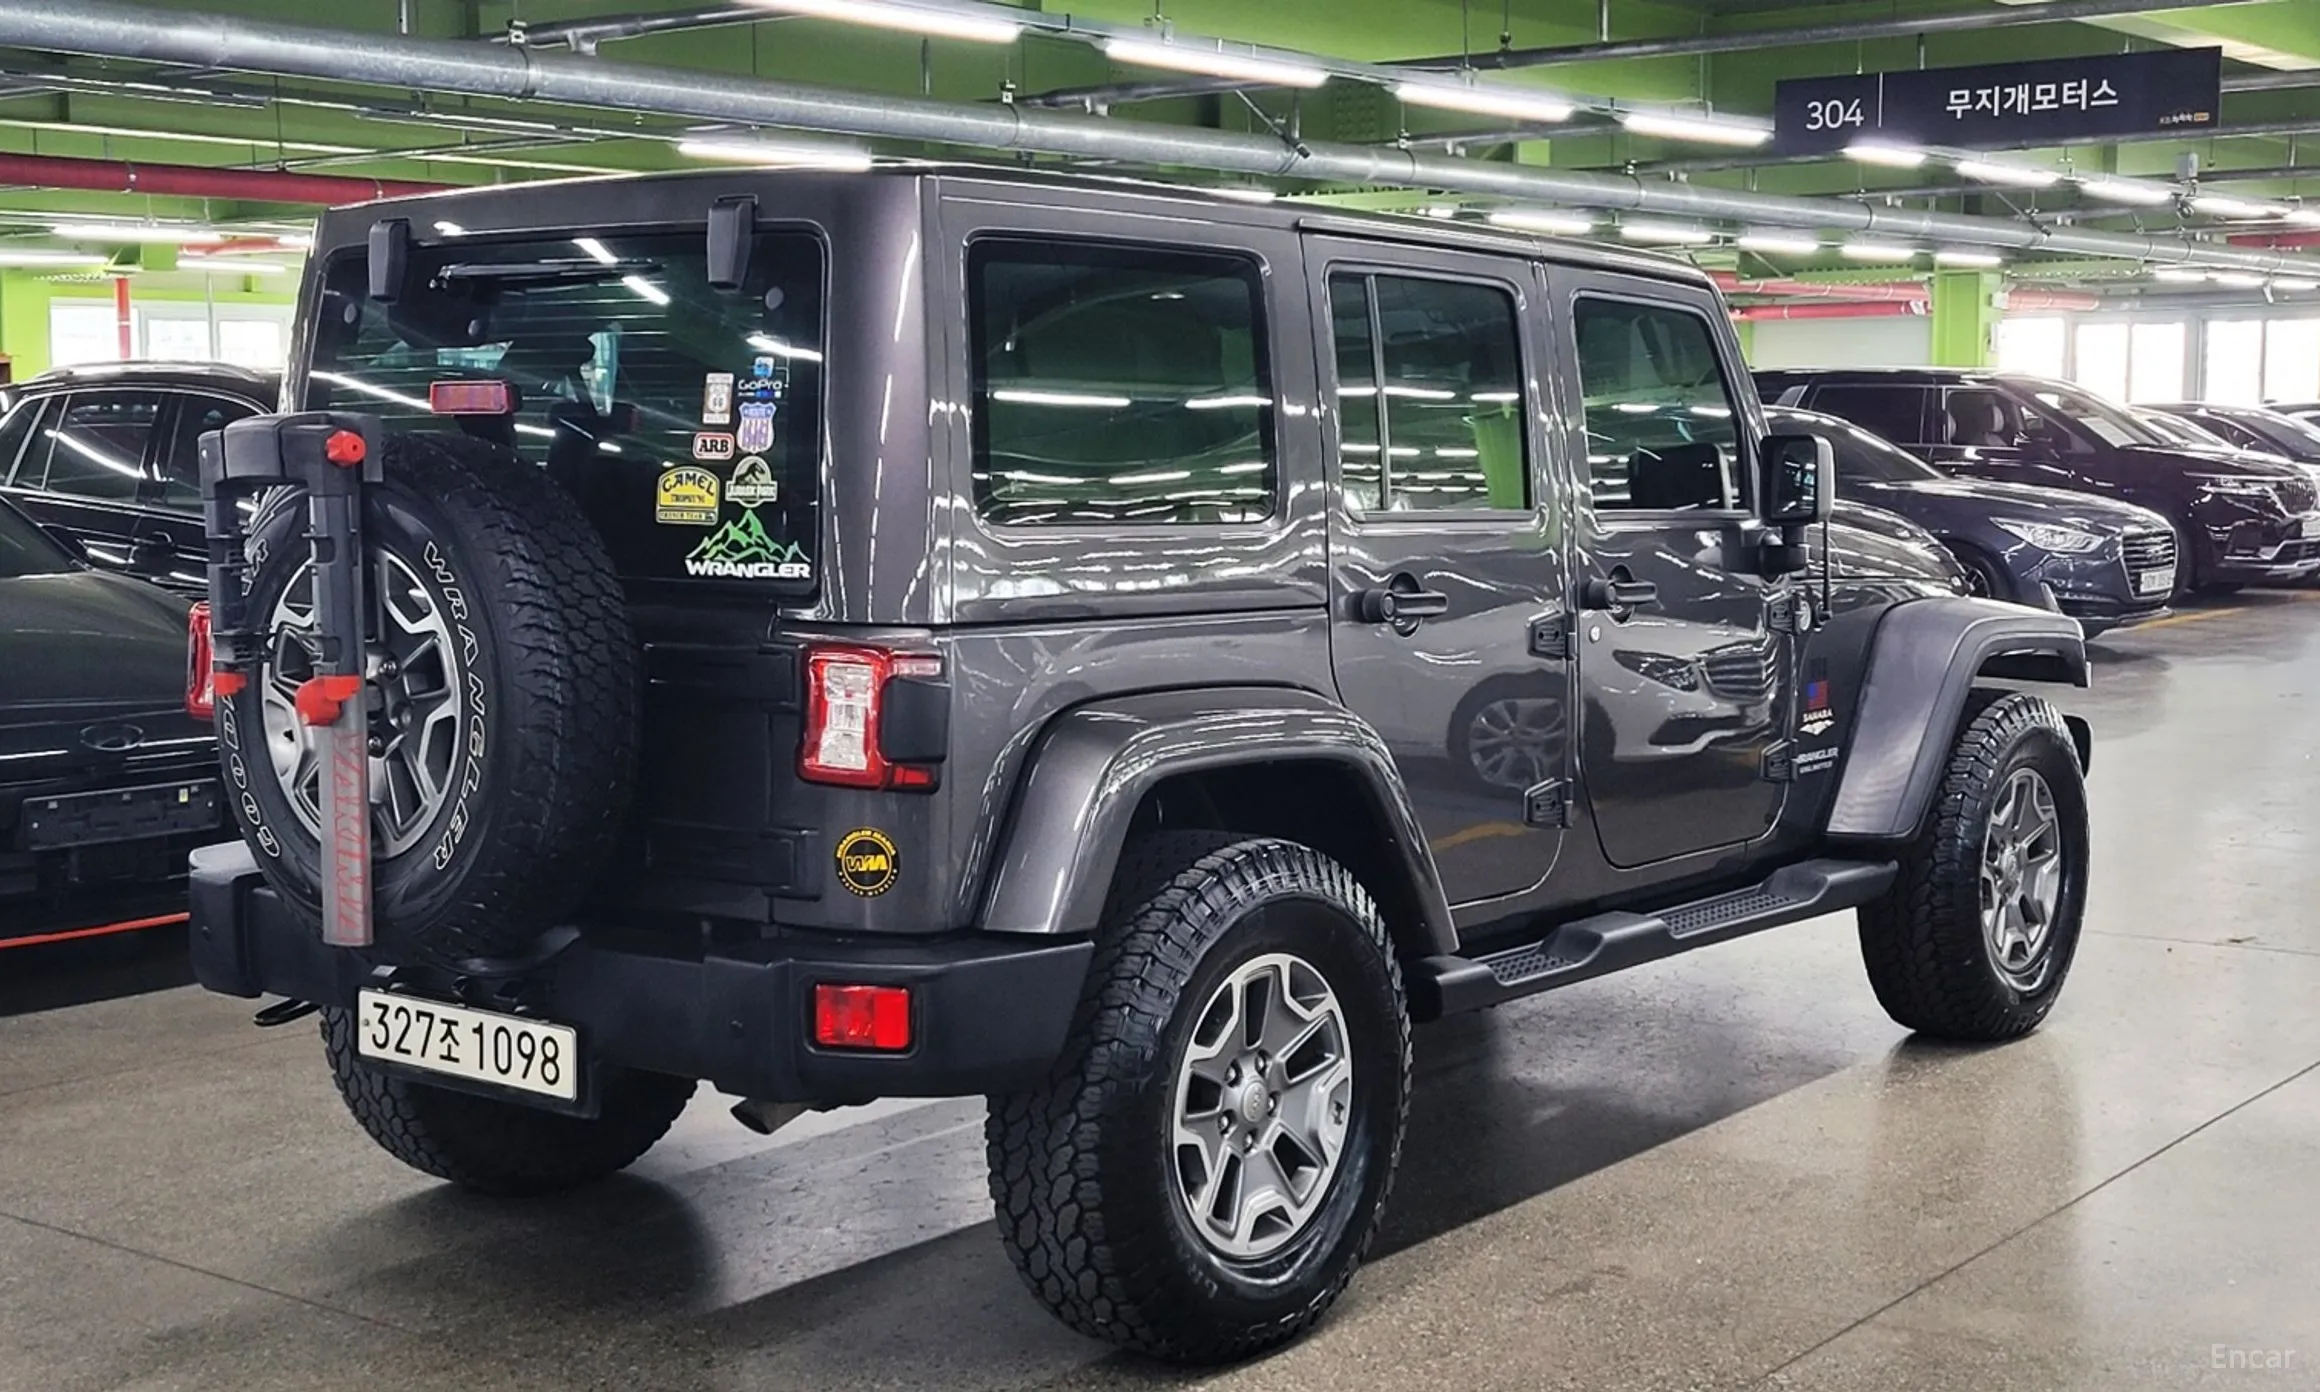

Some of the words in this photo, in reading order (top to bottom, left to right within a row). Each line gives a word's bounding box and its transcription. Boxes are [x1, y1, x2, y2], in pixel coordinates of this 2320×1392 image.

[1946, 78, 2119, 120] 무지개모터스
[1805, 98, 1865, 130] 304
[738, 379, 782, 391] GoPro
[698, 438, 729, 453] ARB
[662, 472, 715, 496] CAMEL
[684, 558, 811, 578] WRANGLER
[424, 541, 486, 870] WRANGLER
[371, 1001, 460, 1064] 327조
[472, 1020, 561, 1086] 1098
